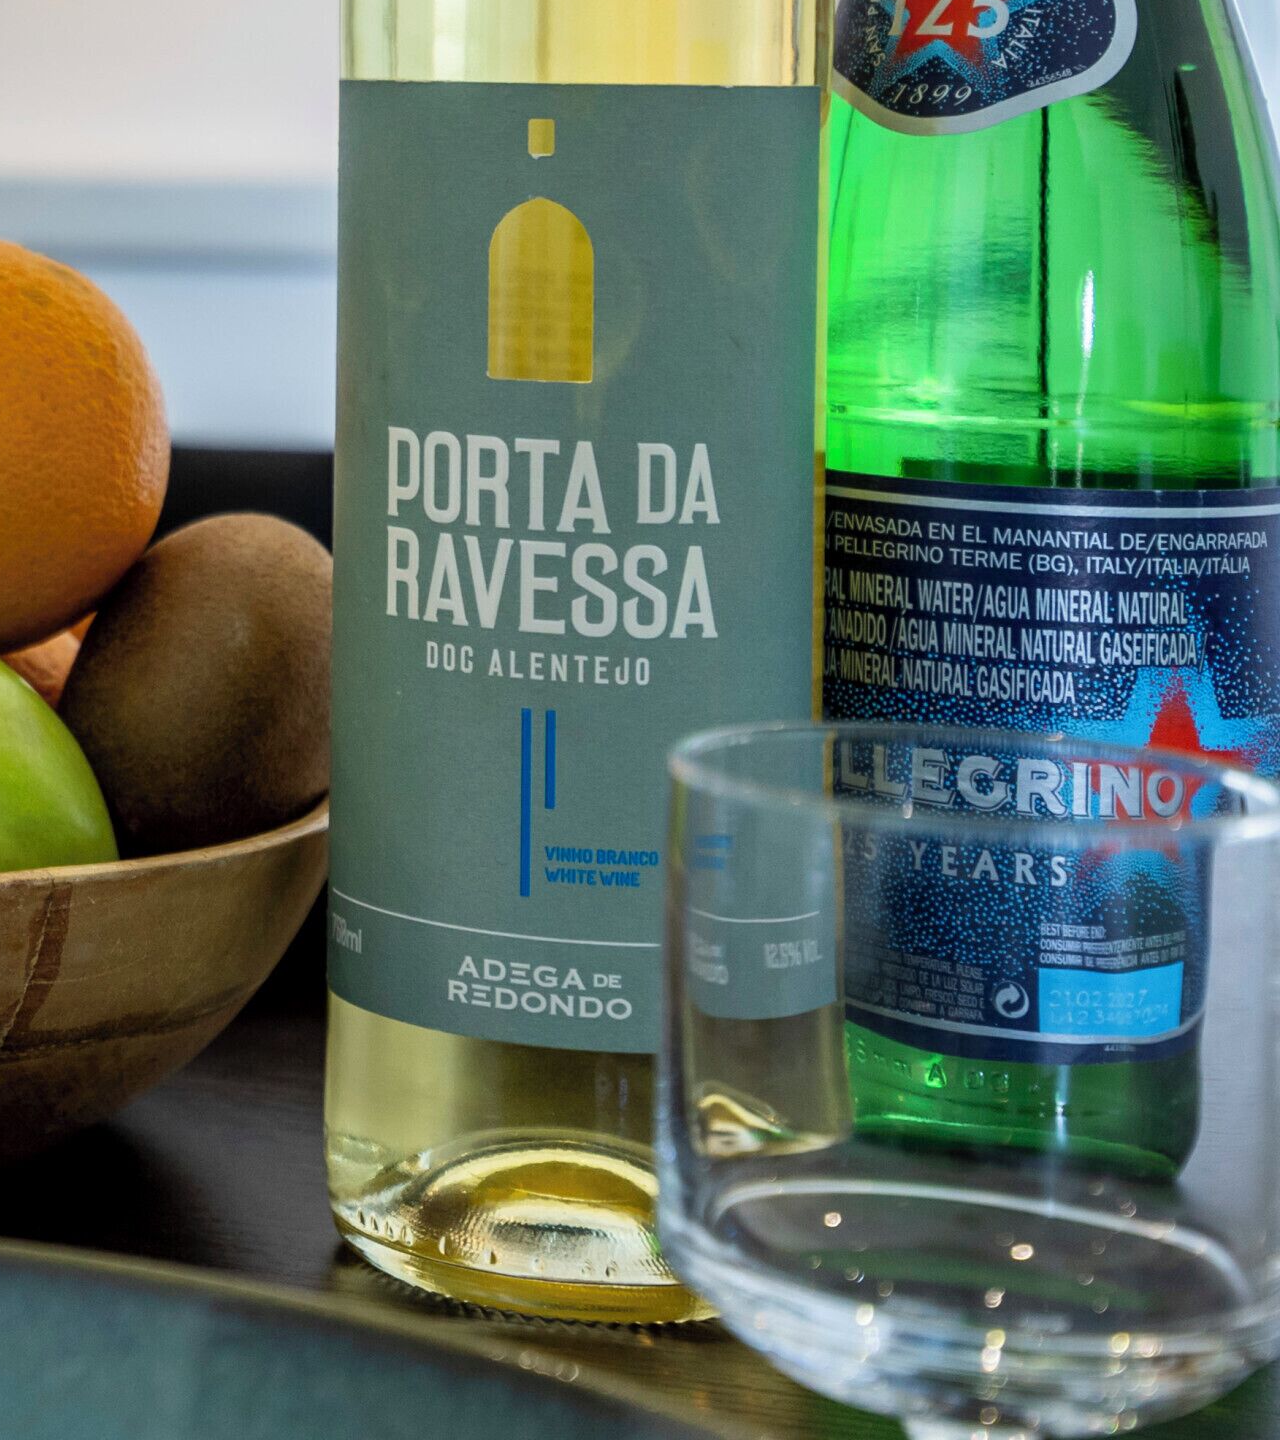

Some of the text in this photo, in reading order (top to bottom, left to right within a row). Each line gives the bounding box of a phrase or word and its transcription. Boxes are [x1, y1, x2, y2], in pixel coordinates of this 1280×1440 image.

[865, 25, 886, 67] SAN
[990, 6, 1041, 70] ITALIA
[891, 83, 972, 105] 1899
[387, 426, 720, 534] PORTA DA
[826, 511, 1268, 555] /ENVASADA EN EL MANANTIAL DE/ENGARRAFADA
[834, 536, 944, 564] PELLEGRINO
[949, 547, 1023, 571] TERME
[1028, 552, 1079, 575] (BG),
[386, 525, 718, 640] RAVESSA
[849, 570, 914, 610] MINERAL
[917, 577, 1031, 624] WATER/AGUA
[1035, 588, 1114, 624] MINERAL
[1118, 591, 1188, 625] NATURAL
[426, 641, 651, 686] DOC ALENTEJO
[943, 621, 1017, 661] MINERAL
[1020, 627, 1096, 665] NATURAL
[1100, 632, 1197, 666] GASEIFICADA
[840, 647, 899, 688] MINERAL
[902, 658, 973, 697] NATURAL
[977, 664, 1076, 705] GASIFICADA
[544, 846, 659, 866] VINHO BRANCO
[544, 867, 641, 888] WHITE WINE
[909, 839, 1069, 888] YEARS
[457, 955, 622, 991] ADEGA DE
[447, 978, 633, 1021] REDONDO
